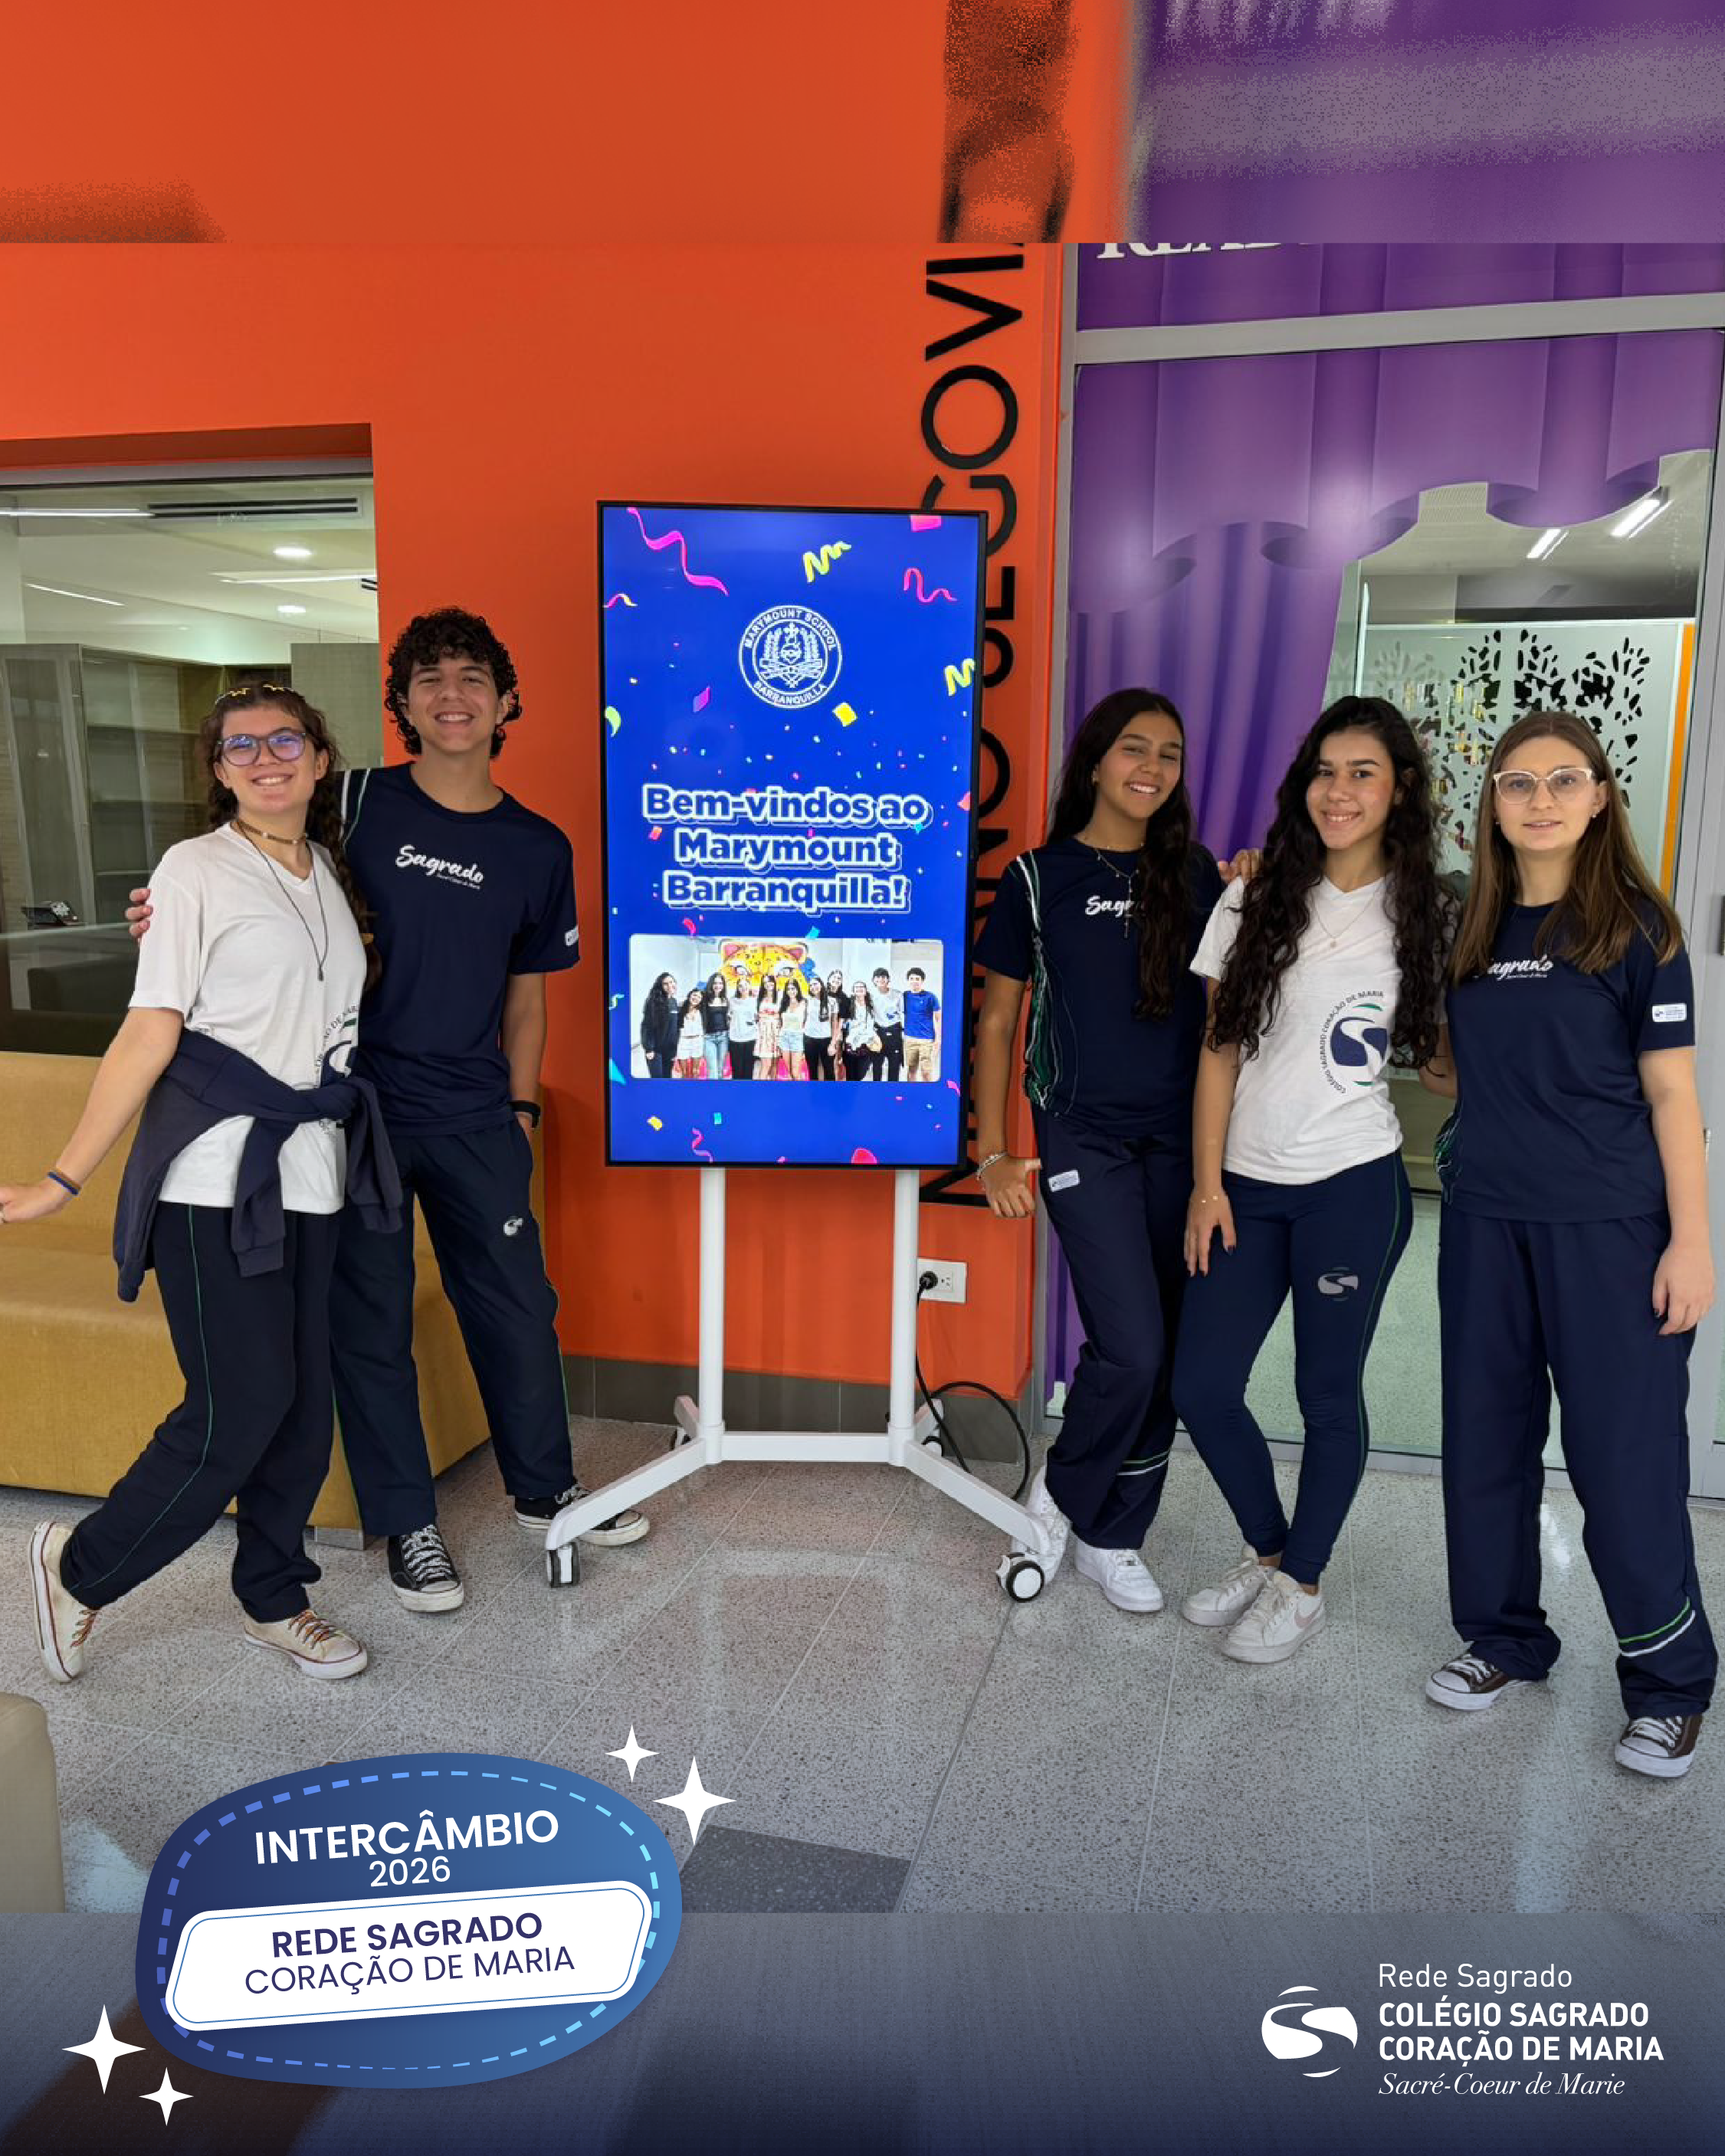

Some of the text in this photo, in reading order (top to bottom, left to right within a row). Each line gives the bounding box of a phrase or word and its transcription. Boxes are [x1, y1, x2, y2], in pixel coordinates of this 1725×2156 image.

[744, 607, 837, 651] MARYMOUNT SCHOOL
[642, 783, 930, 826] Bem-vindos ao
[395, 844, 484, 883] Sagrado
[674, 827, 900, 871] Marymount
[663, 870, 910, 914] Barranquilla!
[1084, 895, 1135, 918] Sagr
